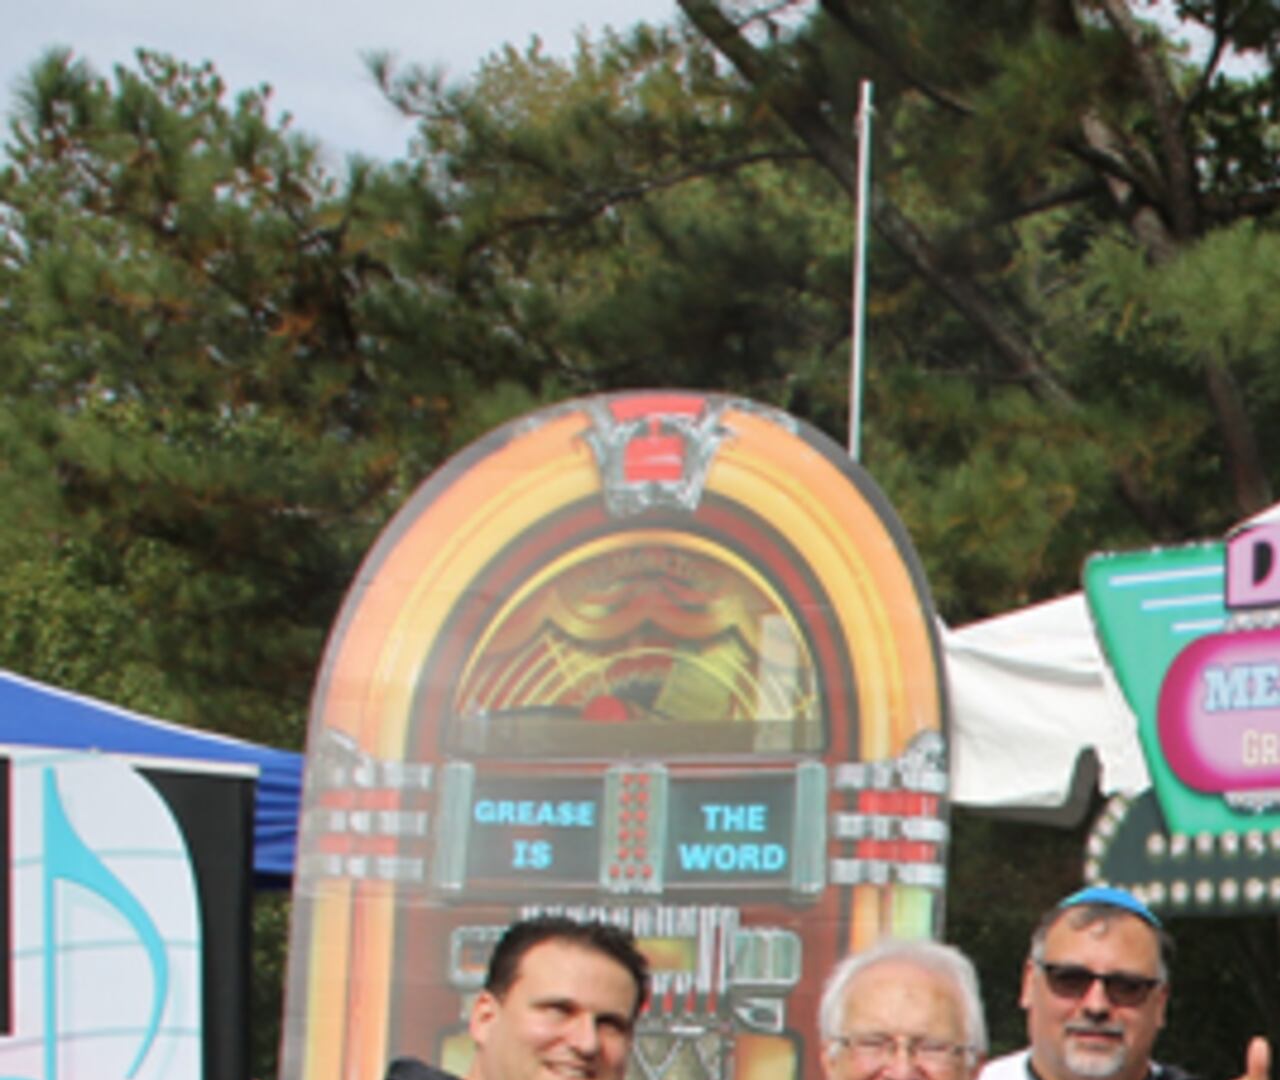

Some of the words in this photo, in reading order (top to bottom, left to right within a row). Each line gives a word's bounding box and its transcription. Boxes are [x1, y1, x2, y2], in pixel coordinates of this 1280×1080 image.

[474, 800, 596, 827] GREASE
[701, 804, 768, 832] THE
[512, 840, 553, 869] IS
[678, 843, 788, 871] WORD
